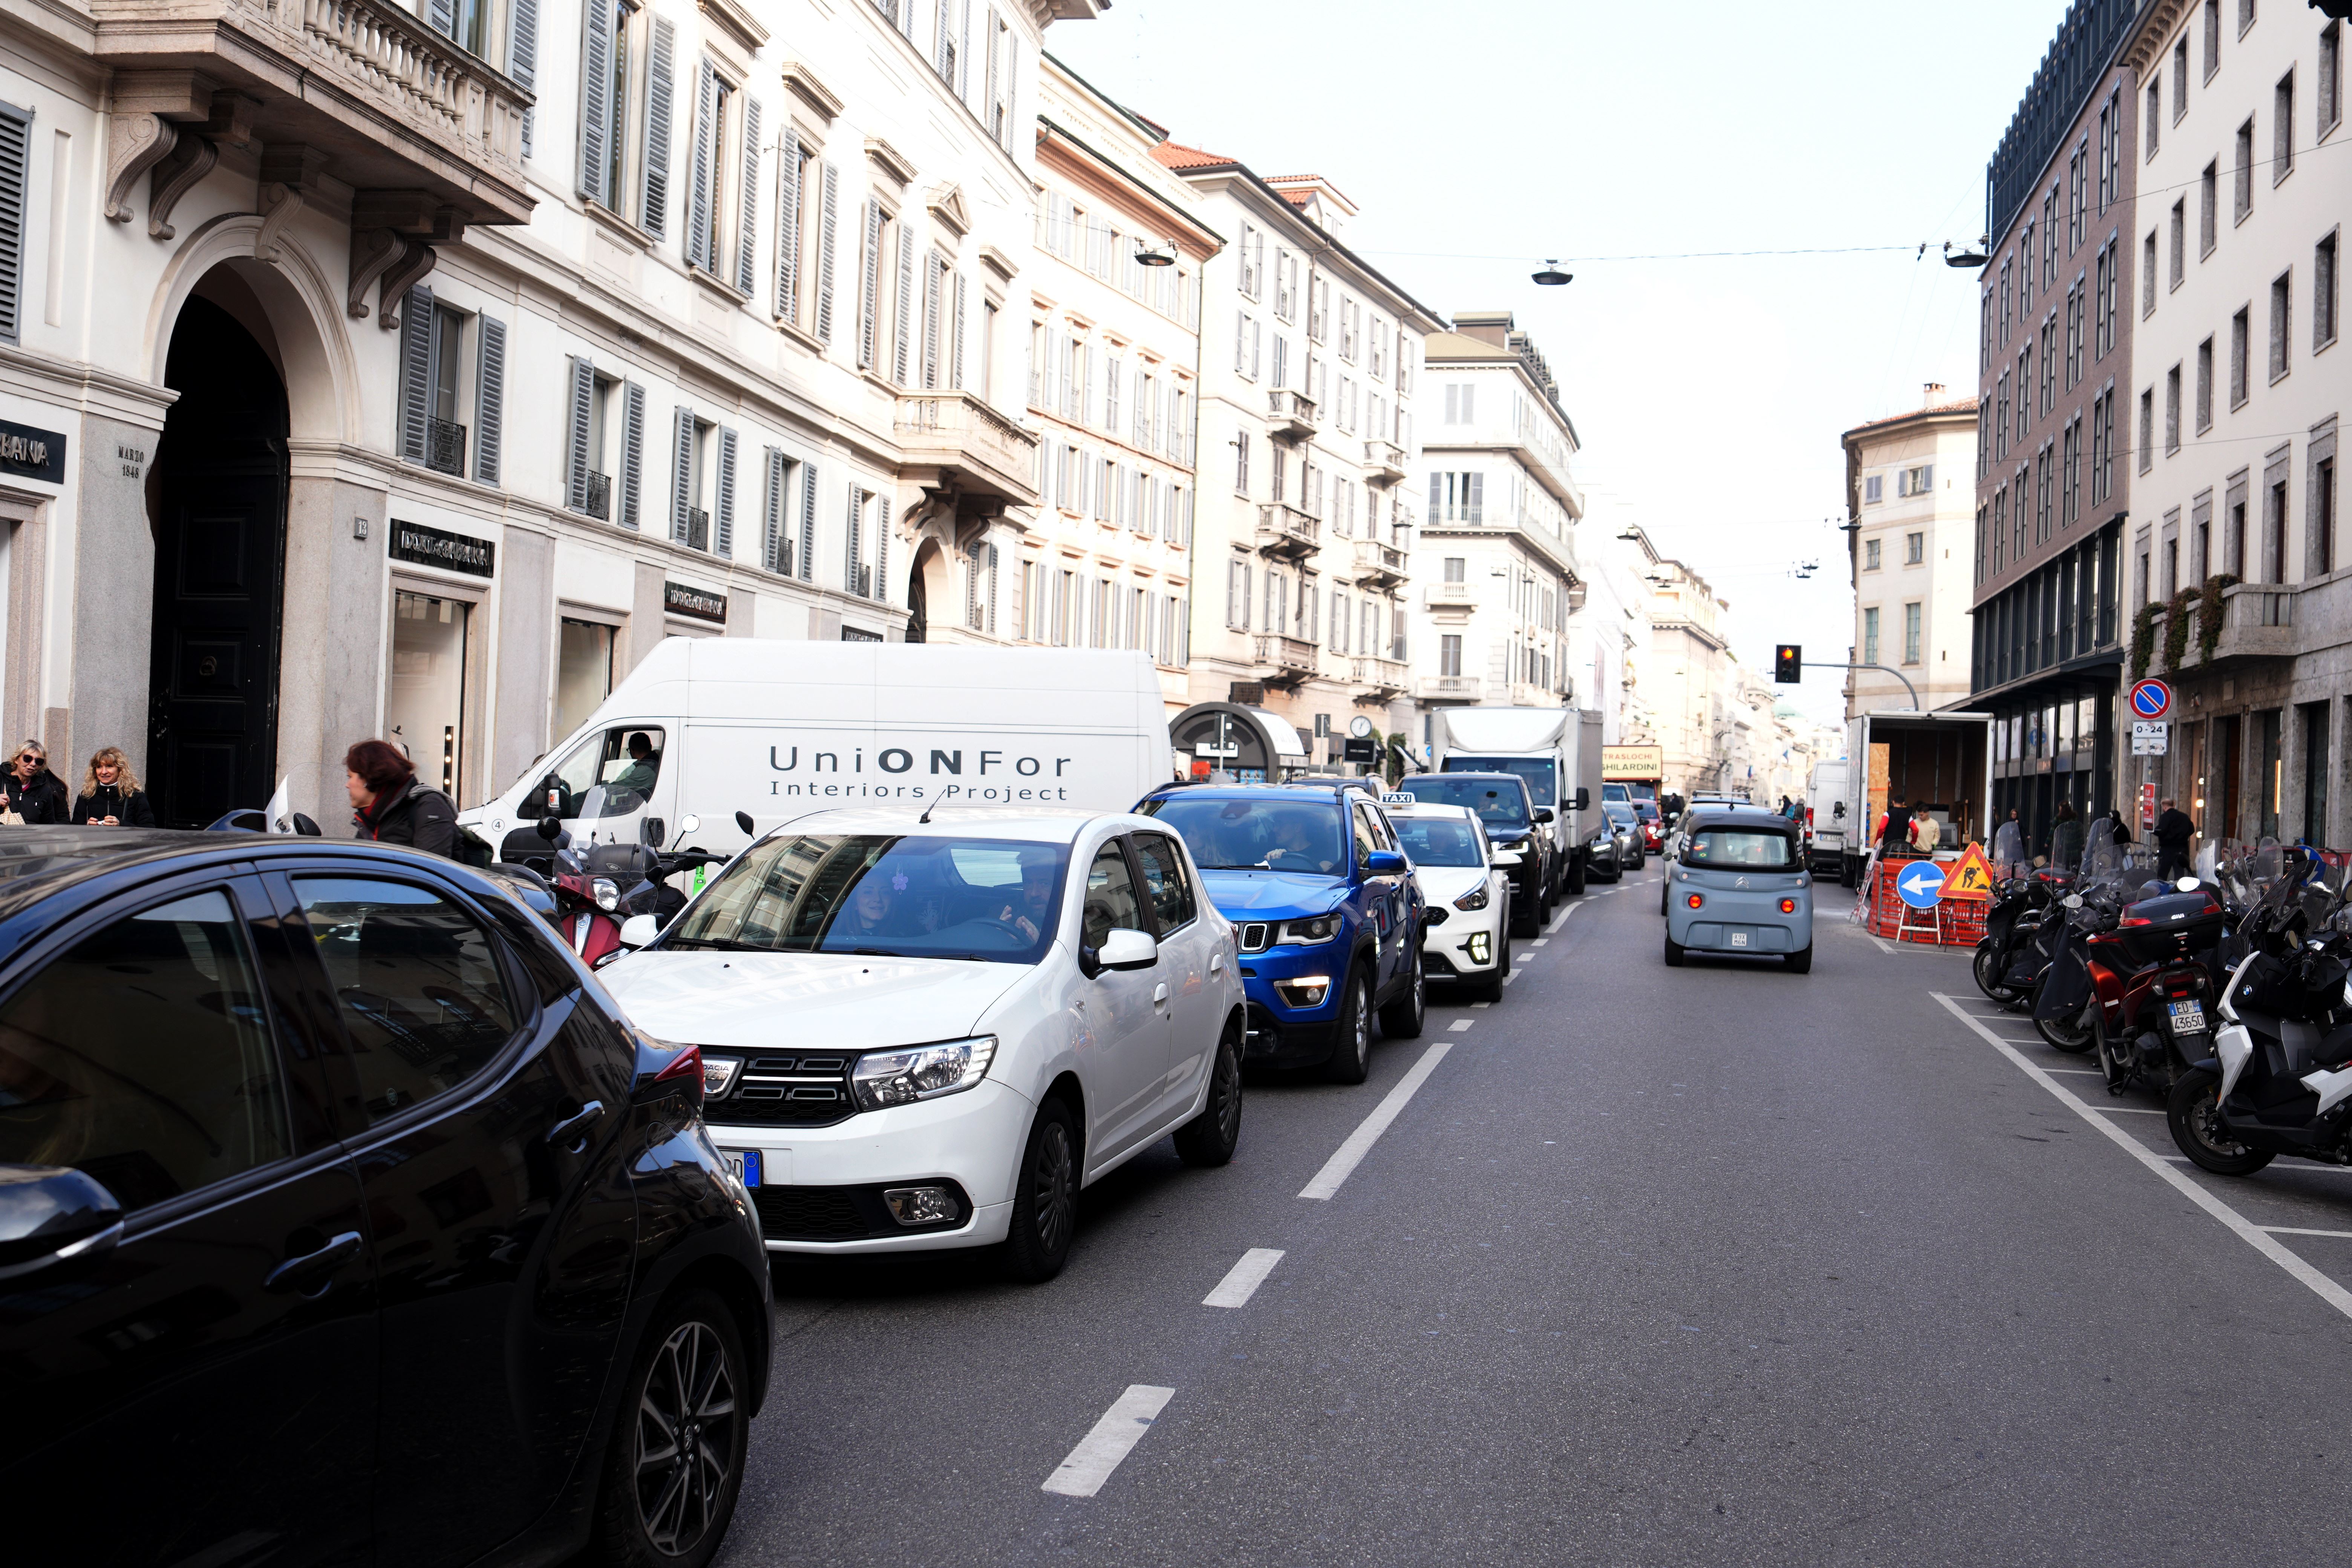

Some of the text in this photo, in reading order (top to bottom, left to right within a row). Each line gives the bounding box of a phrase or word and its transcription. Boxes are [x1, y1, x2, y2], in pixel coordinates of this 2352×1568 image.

[0, 433, 49, 466] BANA
[118, 446, 144, 463] MARZO
[122, 464, 139, 479] 1848
[358, 521, 367, 535] 13
[770, 746, 1071, 777] UniONFor
[770, 781, 1067, 803] Interiors Project
[2176, 1002, 2189, 1014] ED
[2174, 1015, 2204, 1029] 43650
